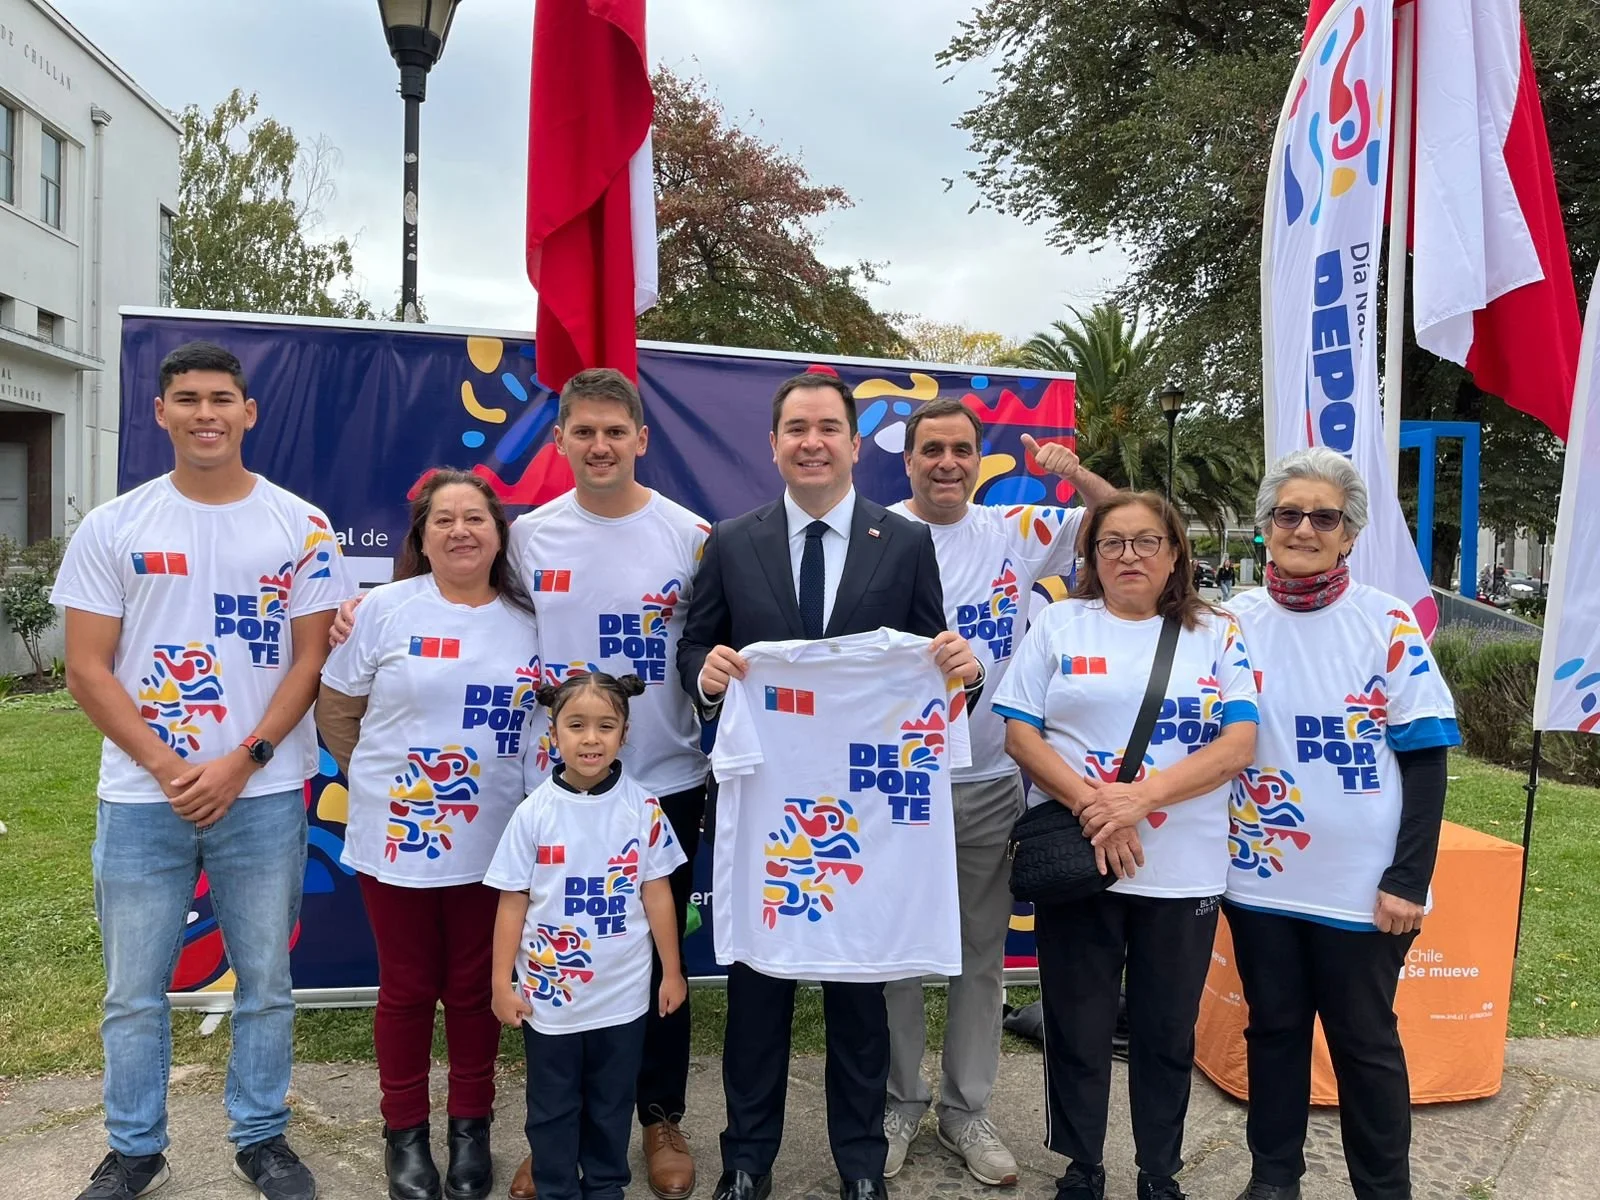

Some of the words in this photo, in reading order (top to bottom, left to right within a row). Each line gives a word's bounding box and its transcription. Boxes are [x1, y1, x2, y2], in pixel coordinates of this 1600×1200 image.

[1, 24, 13, 47] DE
[24, 43, 71, 92] CHILLAN
[1350, 242, 1370, 285] Día
[1312, 249, 1355, 461] DEPO
[361, 529, 388, 546] de
[214, 593, 258, 617] DE
[957, 601, 991, 624] DE
[215, 615, 280, 643] POR
[599, 614, 640, 635] DE
[959, 617, 1013, 641] POR
[249, 642, 280, 665] TE
[600, 637, 666, 659] POR
[988, 637, 1012, 660] TE
[633, 660, 666, 681] TE
[465, 684, 513, 707] DE
[462, 708, 526, 731] POR
[1295, 715, 1346, 740] DE
[495, 732, 521, 754] TE
[1150, 721, 1219, 745] POR
[849, 743, 899, 768] DE
[1297, 740, 1377, 765] POR
[849, 768, 931, 796] POR
[1337, 766, 1380, 790] TE
[888, 795, 930, 821] TE
[565, 877, 605, 896] DE
[565, 895, 627, 917] POR
[595, 915, 627, 936] TE
[1408, 949, 1444, 963] Chile
[1408, 965, 1426, 977] Se
[1430, 967, 1479, 977] mueve
